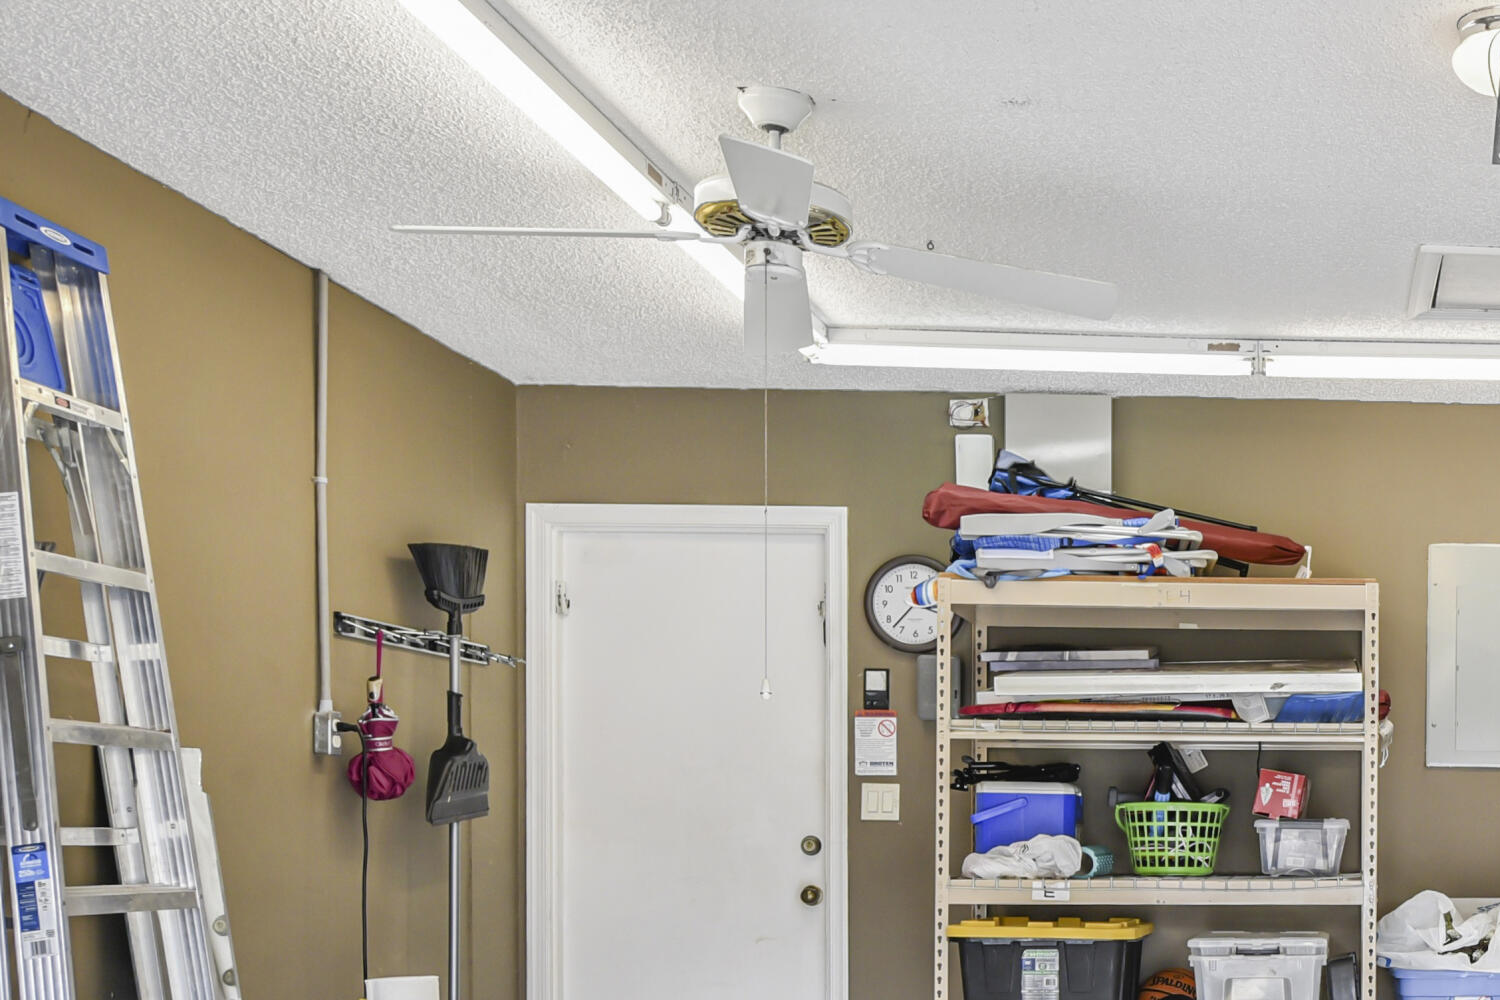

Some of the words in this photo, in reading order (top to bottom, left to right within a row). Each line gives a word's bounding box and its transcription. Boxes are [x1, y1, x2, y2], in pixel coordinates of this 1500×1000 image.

[895, 574, 903, 583] 11
[910, 570, 918, 579] 12
[884, 584, 894, 594] 10
[882, 599, 888, 609] 9
[886, 615, 892, 624] 8
[898, 625, 905, 634] 7
[912, 629, 919, 638] 6
[927, 625, 934, 635] 5
[1152, 976, 1196, 996] SPALDIN
